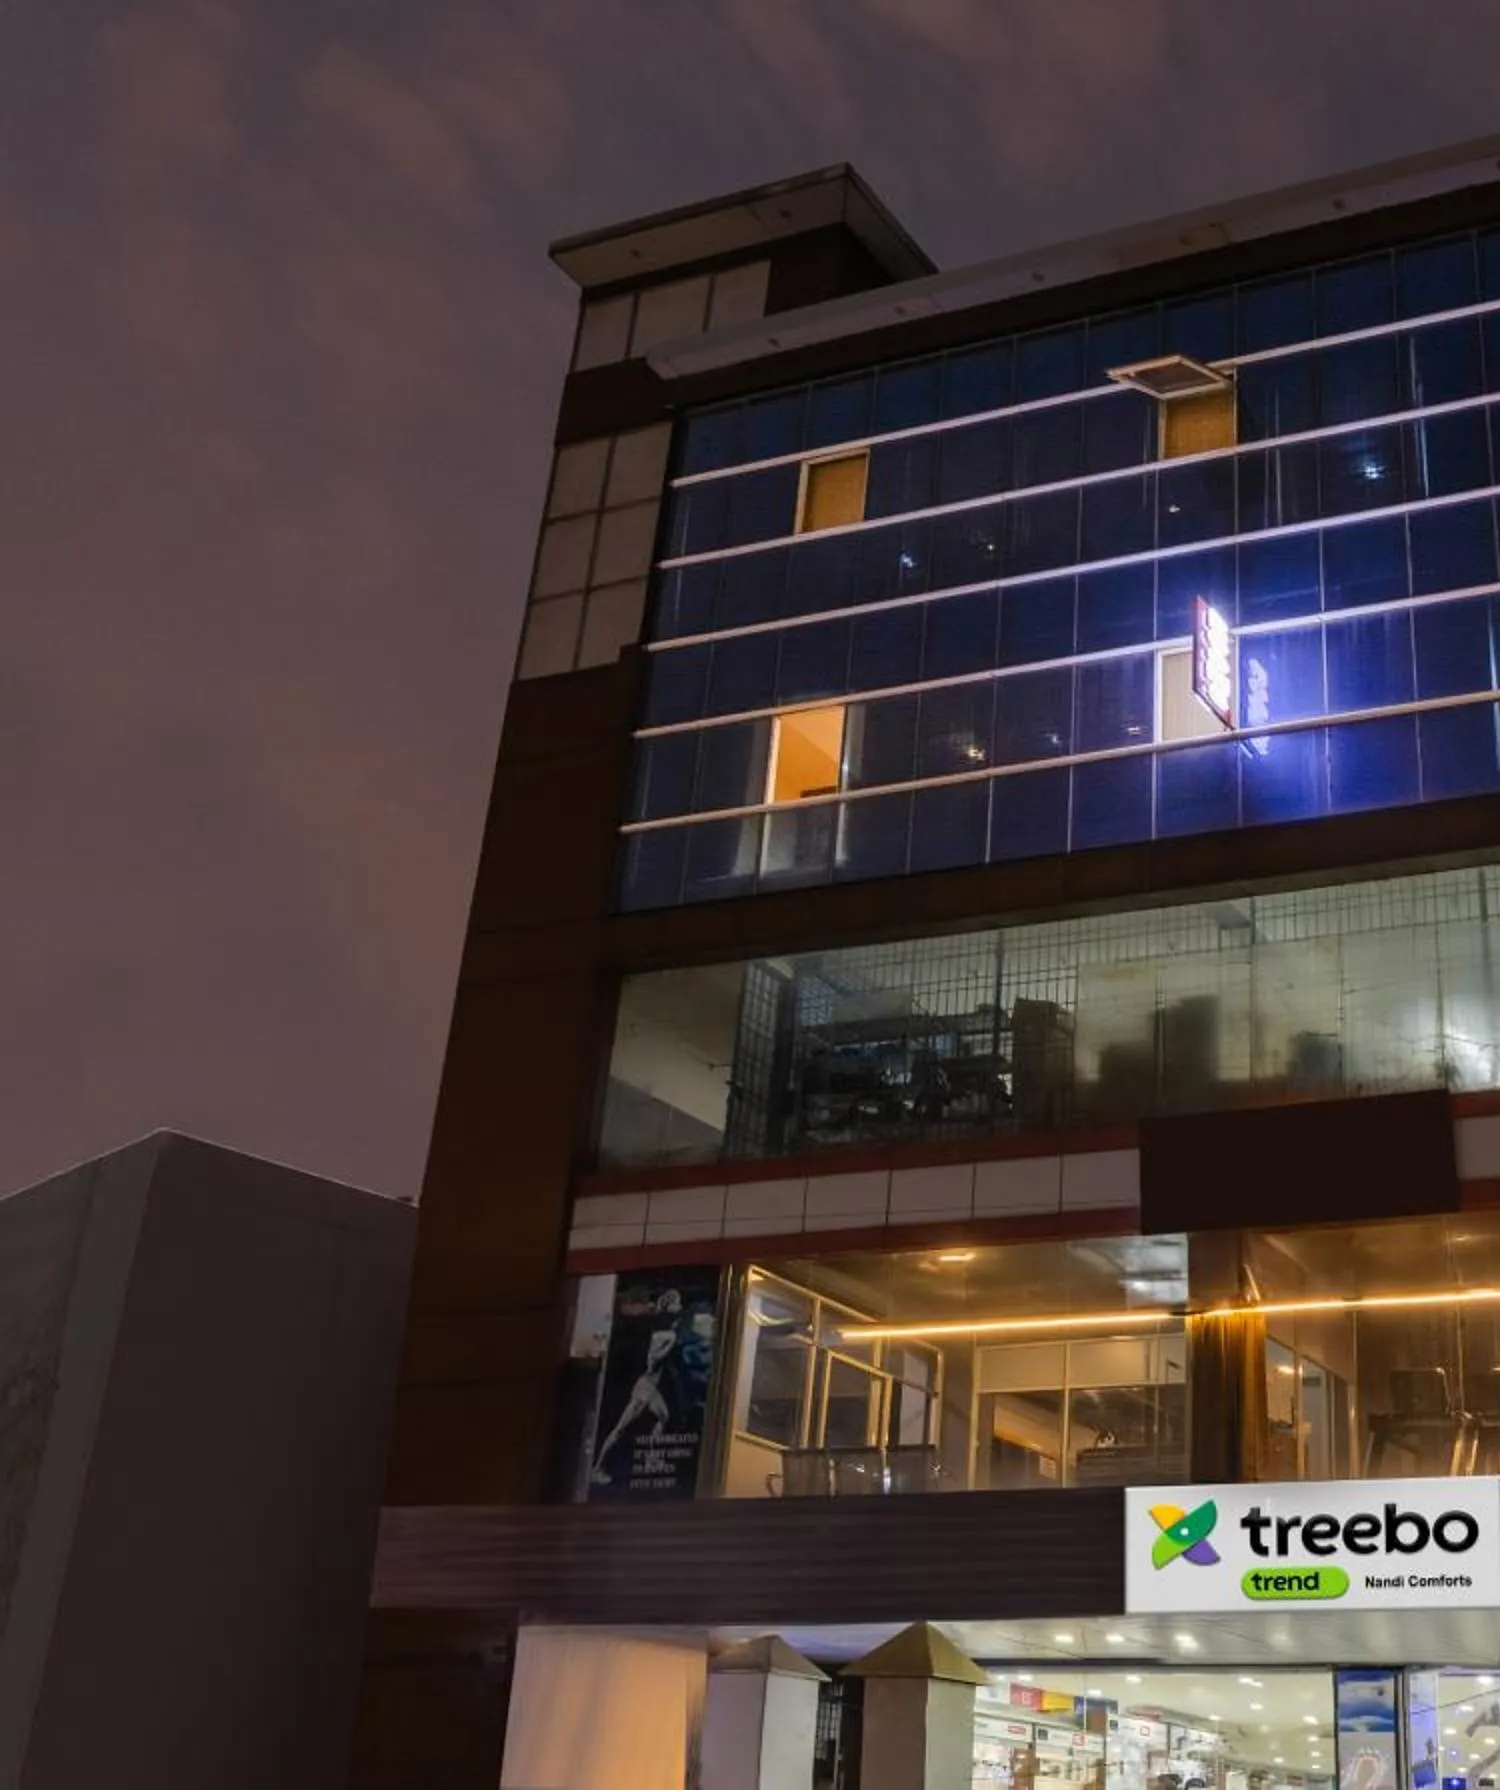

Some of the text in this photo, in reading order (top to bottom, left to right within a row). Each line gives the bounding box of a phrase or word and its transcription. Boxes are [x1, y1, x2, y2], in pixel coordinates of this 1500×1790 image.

[1240, 1504, 1479, 1557] treebo
[1251, 1572, 1320, 1592] trend
[1365, 1573, 1473, 1589] Nandi Comforts
